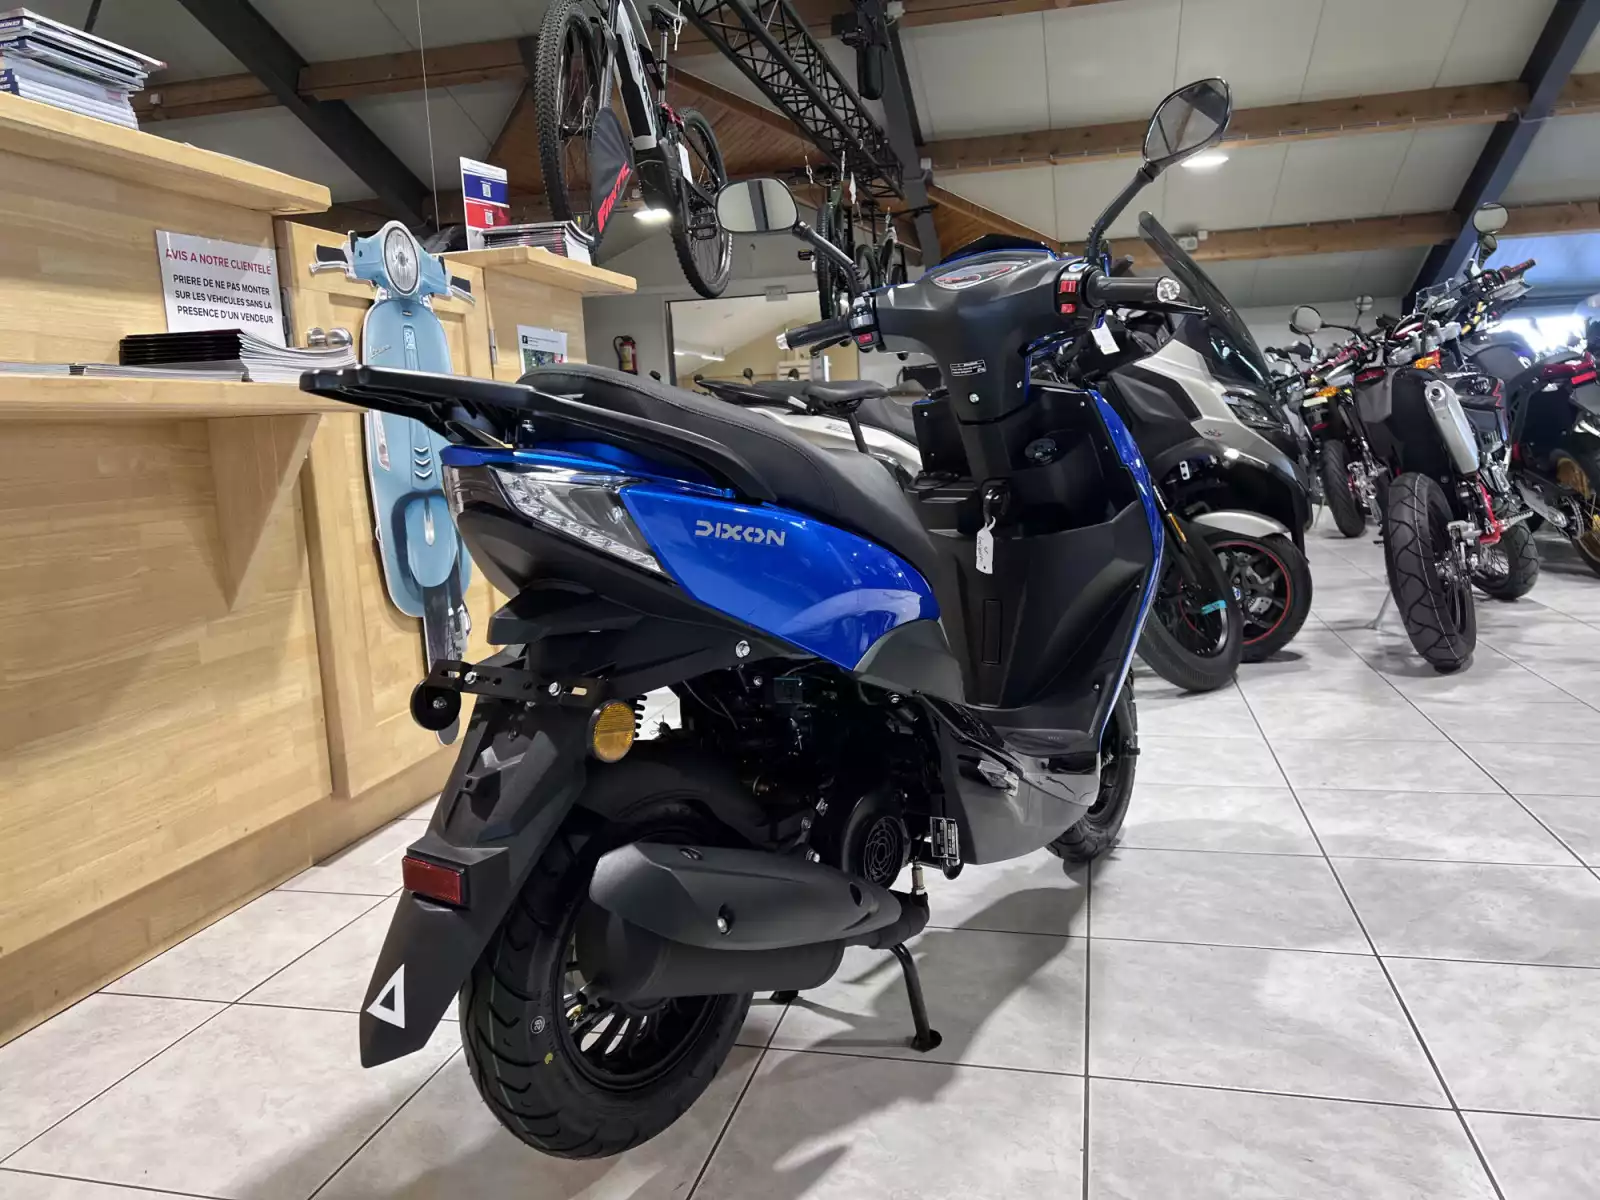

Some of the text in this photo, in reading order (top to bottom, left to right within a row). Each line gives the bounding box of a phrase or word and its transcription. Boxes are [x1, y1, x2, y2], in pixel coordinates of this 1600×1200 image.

[166, 248, 272, 275] AVIS A NOTRE CLIENTELE
[173, 274, 270, 296] PRIERE DE NE PAS MONTER
[175, 290, 272, 309] SUR LES VEHICULES SANS LA
[177, 305, 274, 324] PRESENCE D'UN VENDEUR
[695, 519, 786, 547] DIXON
